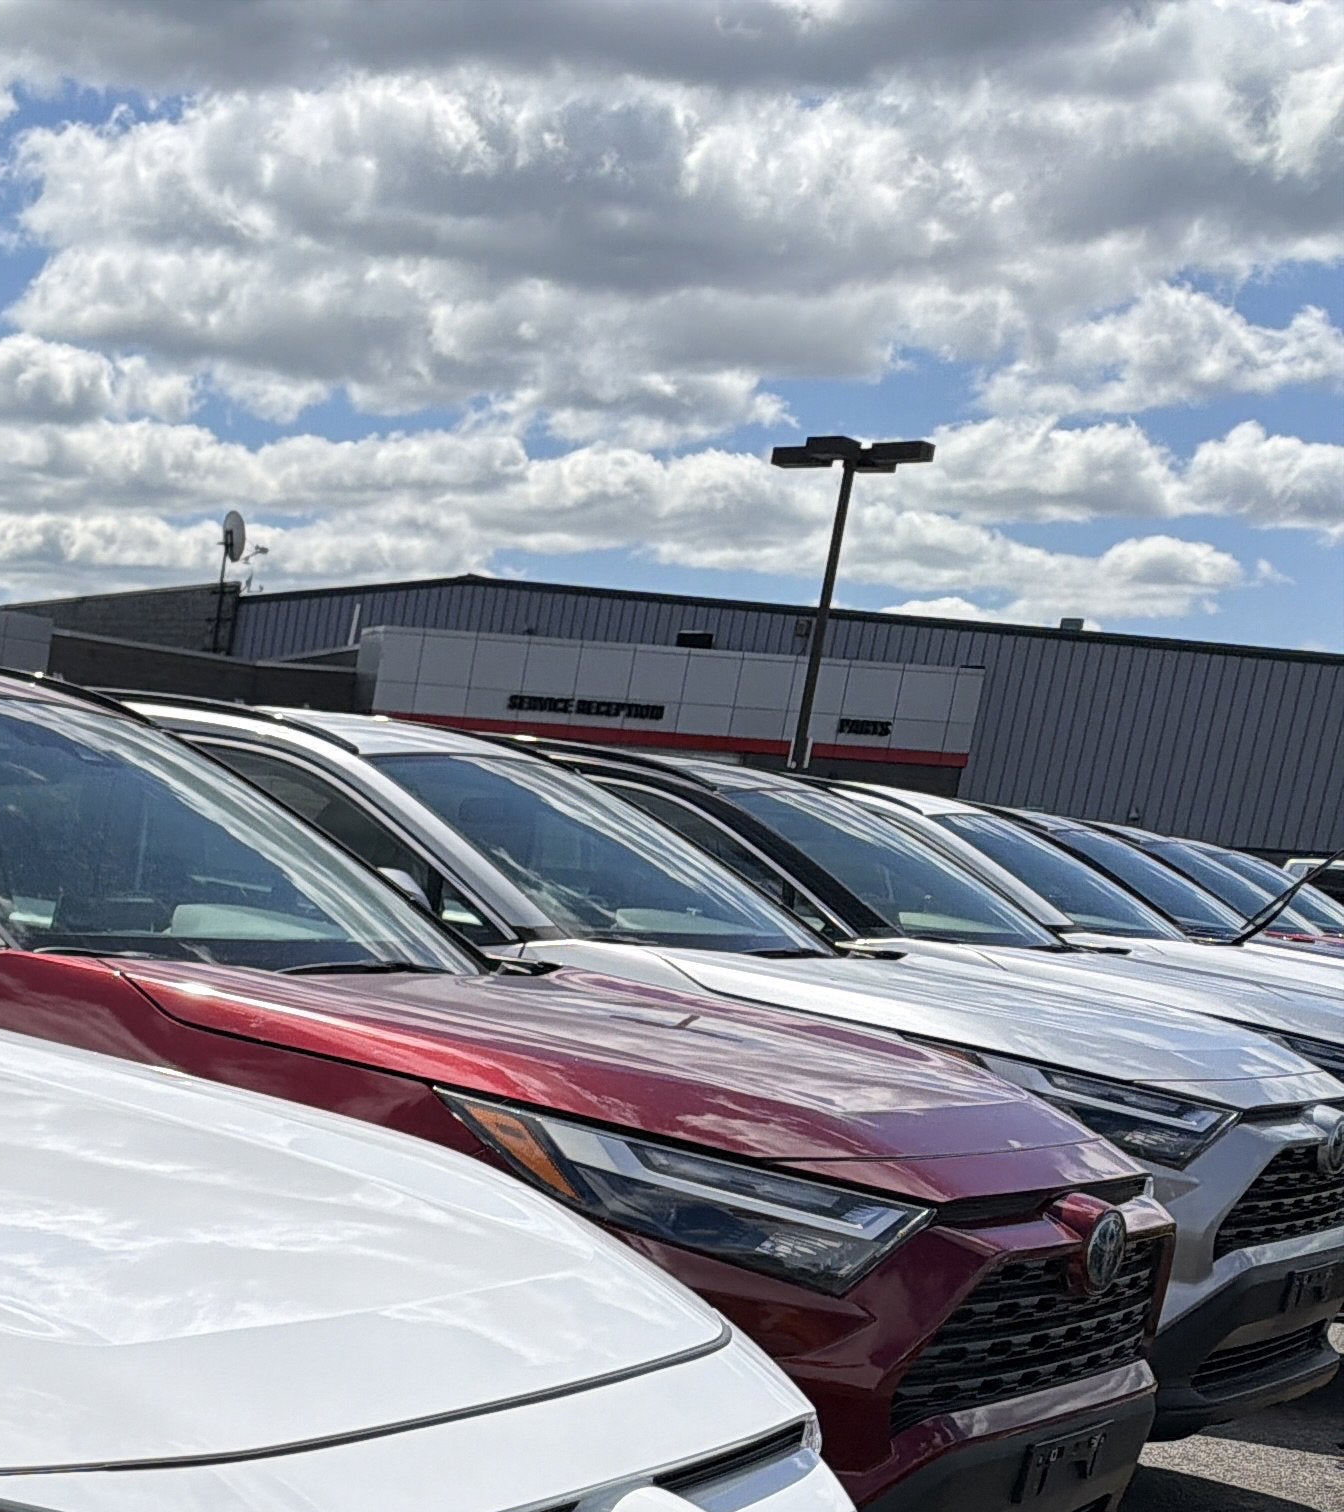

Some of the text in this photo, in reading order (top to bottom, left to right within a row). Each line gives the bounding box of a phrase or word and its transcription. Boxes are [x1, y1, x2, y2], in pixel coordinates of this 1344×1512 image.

[507, 694, 665, 720] SERVICE RECEPTION
[838, 718, 893, 737] PARTS
